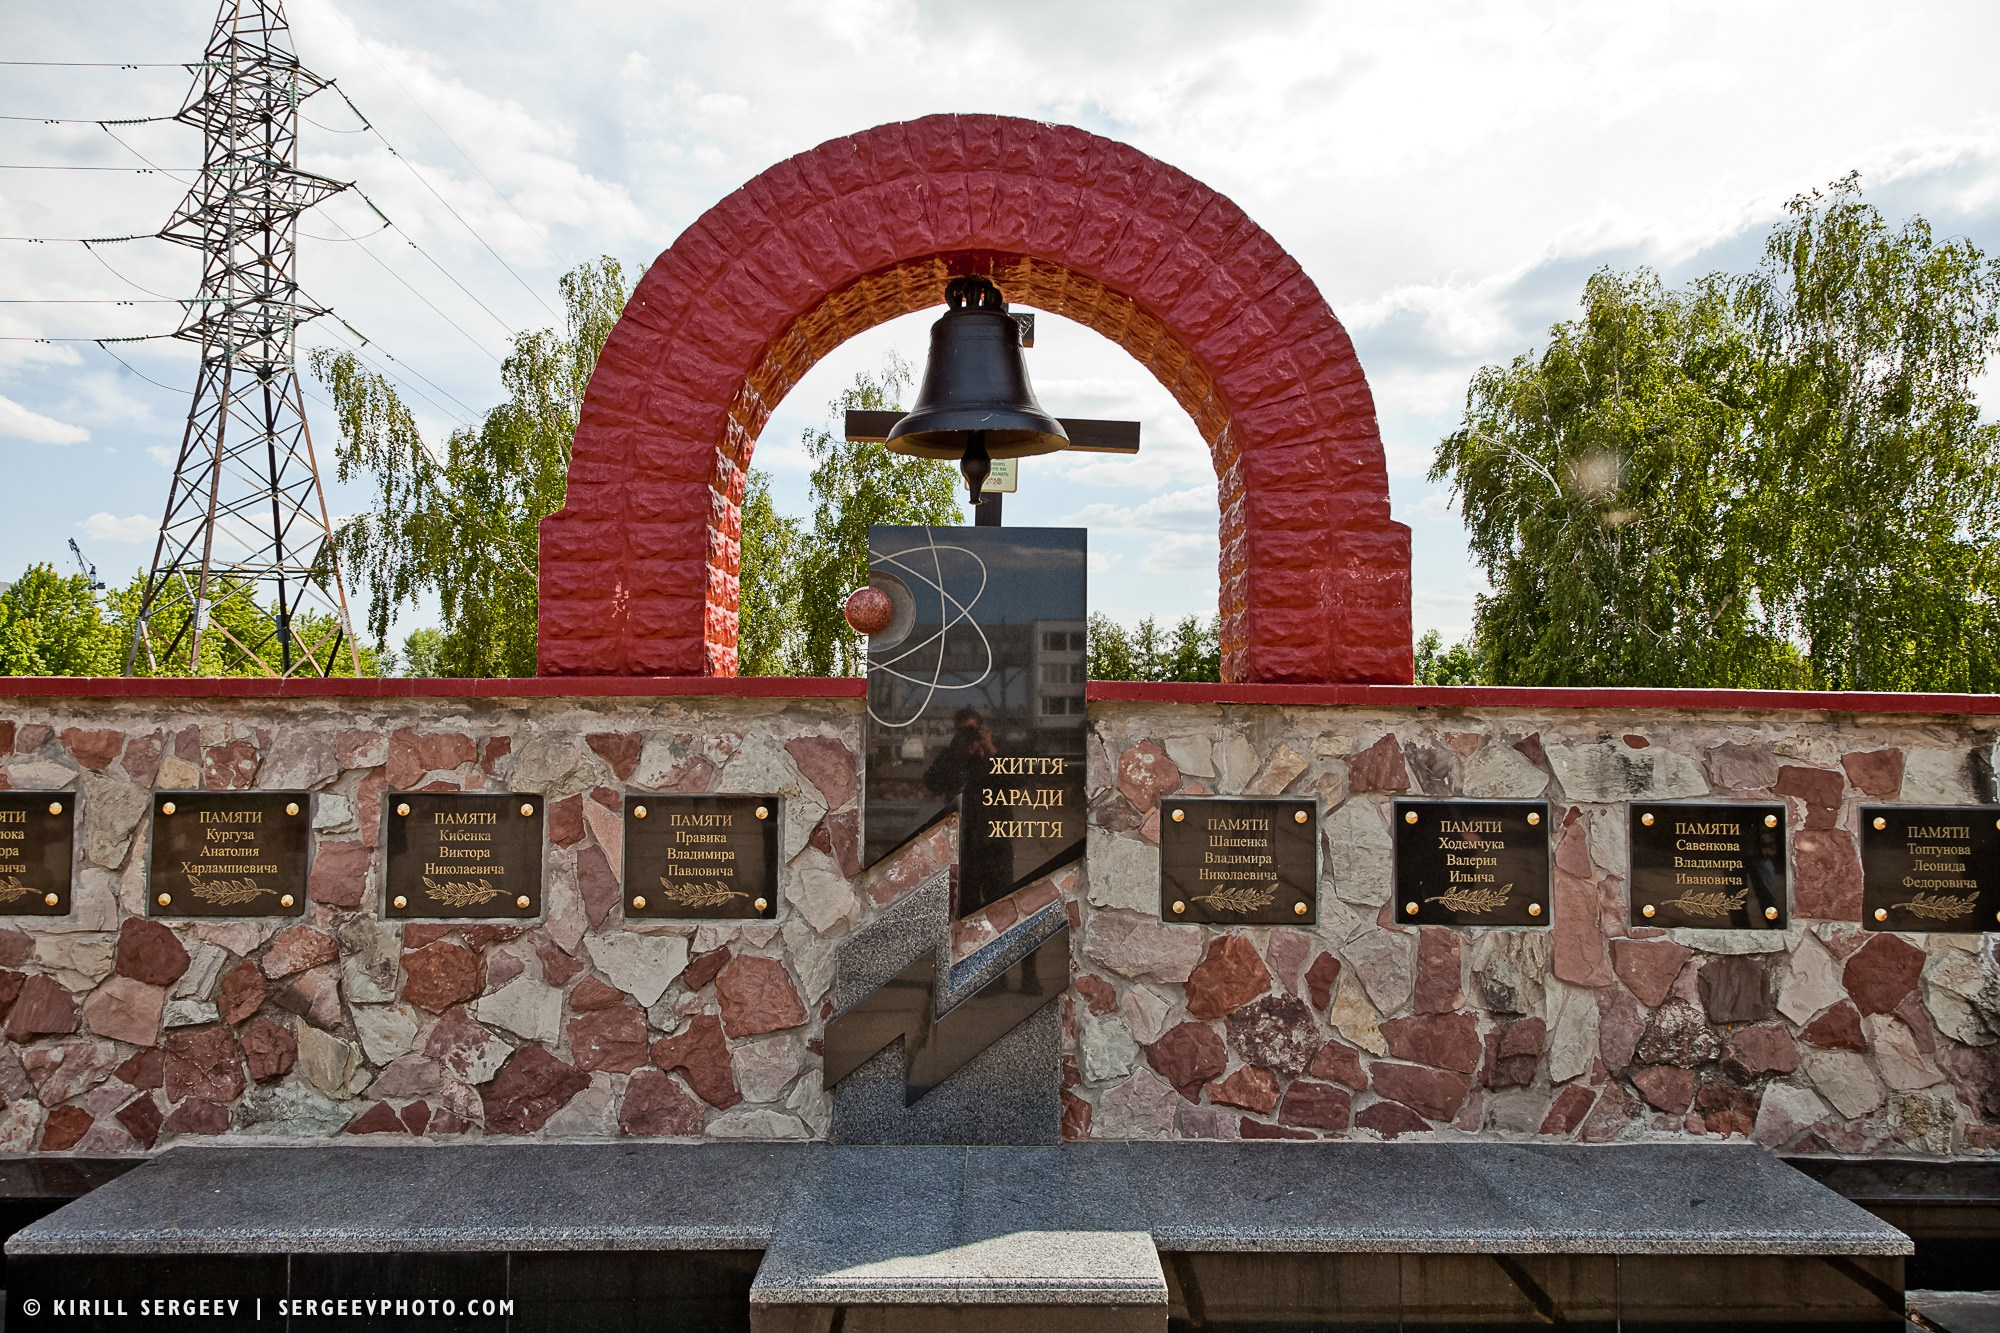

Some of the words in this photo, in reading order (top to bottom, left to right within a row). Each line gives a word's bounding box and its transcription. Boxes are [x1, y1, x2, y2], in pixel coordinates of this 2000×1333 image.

[982, 788, 1064, 811] ЗАРАДИ
[200, 811, 263, 824] ПАМЯТИ
[434, 812, 497, 825] ПАМЯТИ
[670, 814, 733, 827] ПАМЯТИ
[988, 820, 1064, 838] ЖИТТЯ
[1207, 818, 1270, 831] ПАМЯТИ
[1440, 820, 1503, 833] ПАМЯТИ
[1674, 822, 1740, 835] ПАМЯТИ
[206, 828, 255, 843] Кургуза
[439, 829, 492, 842] Кибенка
[675, 831, 727, 846] Правика
[1907, 826, 1970, 839] ПАМЯТИ
[1209, 835, 1268, 848] Шашенка
[1438, 836, 1505, 852] Ходемчука
[1675, 838, 1741, 852] Савенкова
[199, 845, 260, 857] Анатолия
[439, 846, 491, 860] Виктора
[666, 847, 735, 863] Владимира
[1906, 842, 1972, 856] Топтунова
[1204, 851, 1273, 868] Владимира
[1446, 853, 1497, 868] Валерия
[1673, 856, 1744, 872] Владимира
[180, 861, 278, 876] Харлампиевича
[424, 862, 505, 875] Николаевича
[668, 864, 734, 877] Павловича
[1912, 859, 1967, 874] Леонида
[1199, 868, 1278, 881] Николаевича
[1449, 870, 1495, 883] Ильича
[1675, 873, 1743, 885] Ивановича
[1901, 875, 1978, 889] Федоровича
